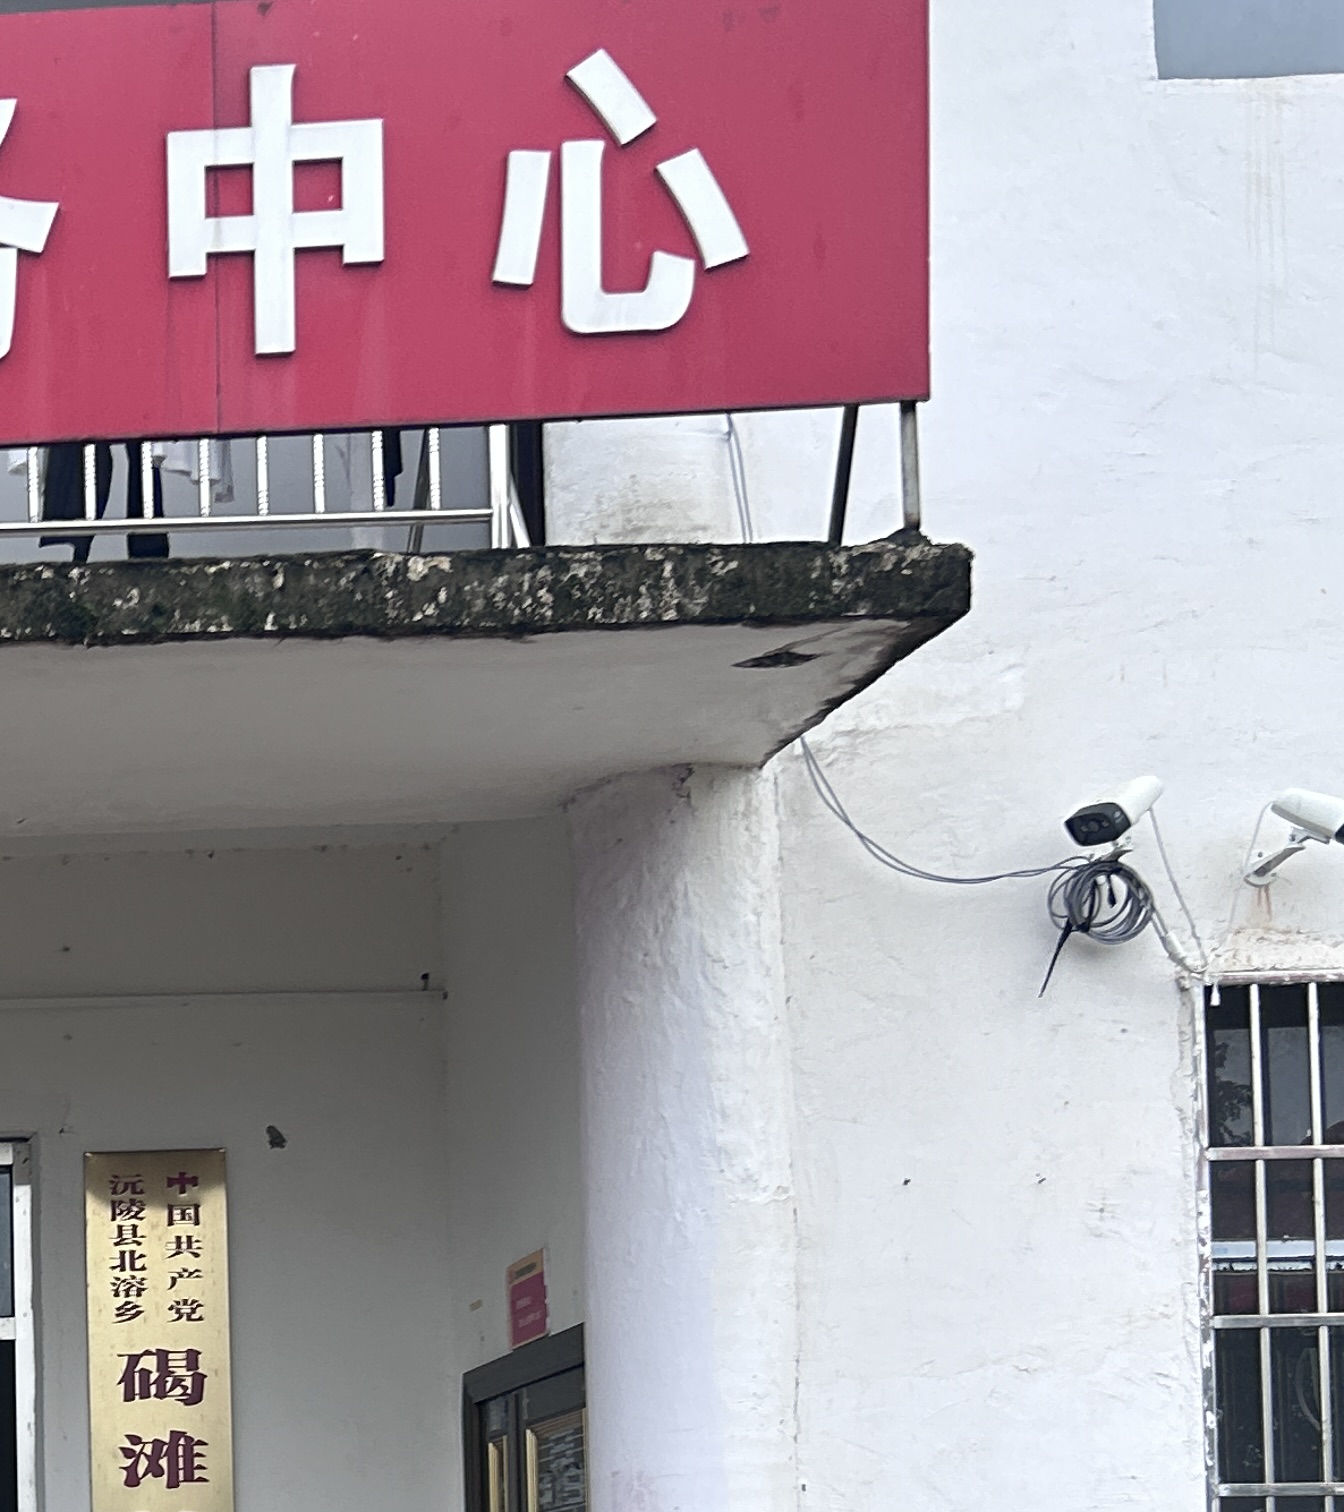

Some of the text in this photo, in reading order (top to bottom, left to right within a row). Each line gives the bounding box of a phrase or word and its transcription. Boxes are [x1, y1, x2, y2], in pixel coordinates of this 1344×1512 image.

[109, 1174, 148, 1324] 沅陵县北溶乡
[165, 1172, 204, 1322] 中国共产党
